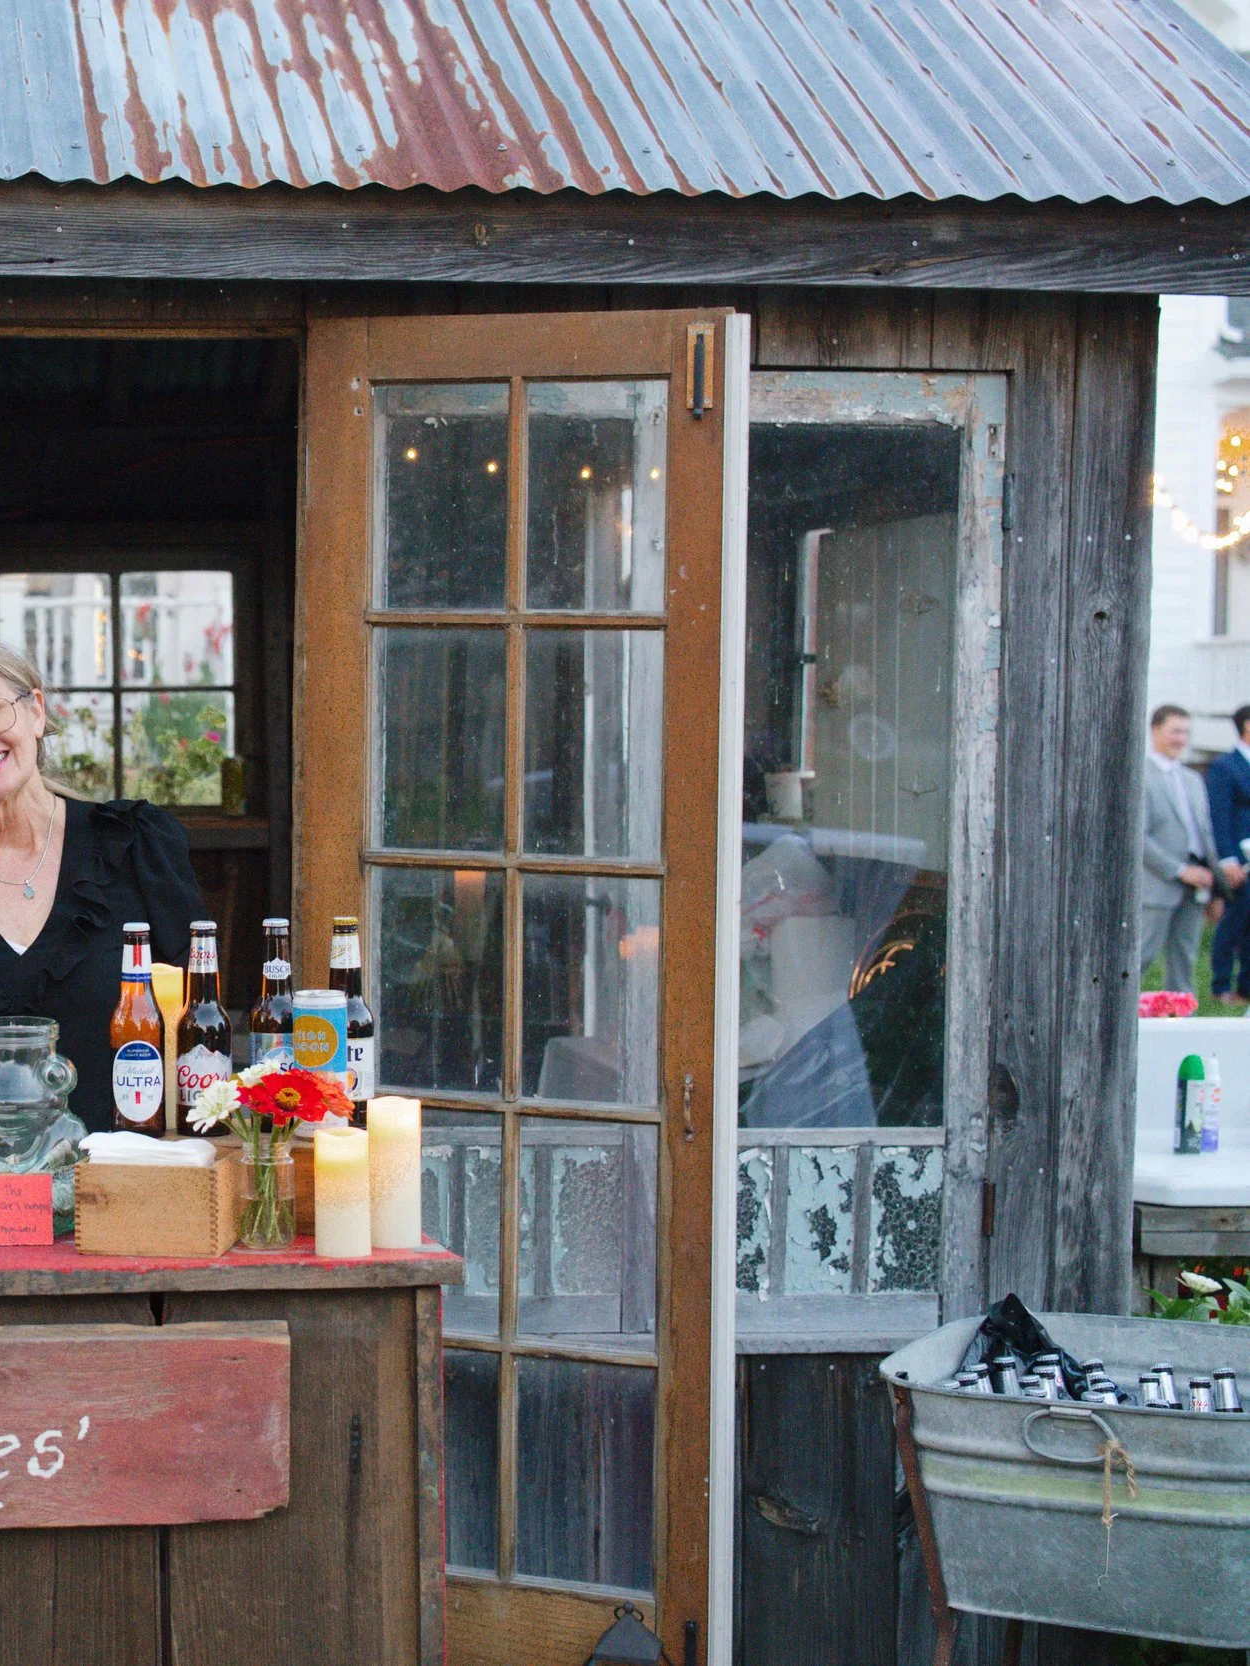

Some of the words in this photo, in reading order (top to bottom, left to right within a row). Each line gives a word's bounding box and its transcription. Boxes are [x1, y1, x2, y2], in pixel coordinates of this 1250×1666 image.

[190, 946, 215, 960] Coors
[264, 964, 290, 974] BUSCH
[347, 1045, 364, 1062] te
[116, 1076, 161, 1087] ULTRA
[177, 1065, 229, 1089] Coors
[180, 1089, 205, 1101] LIG
